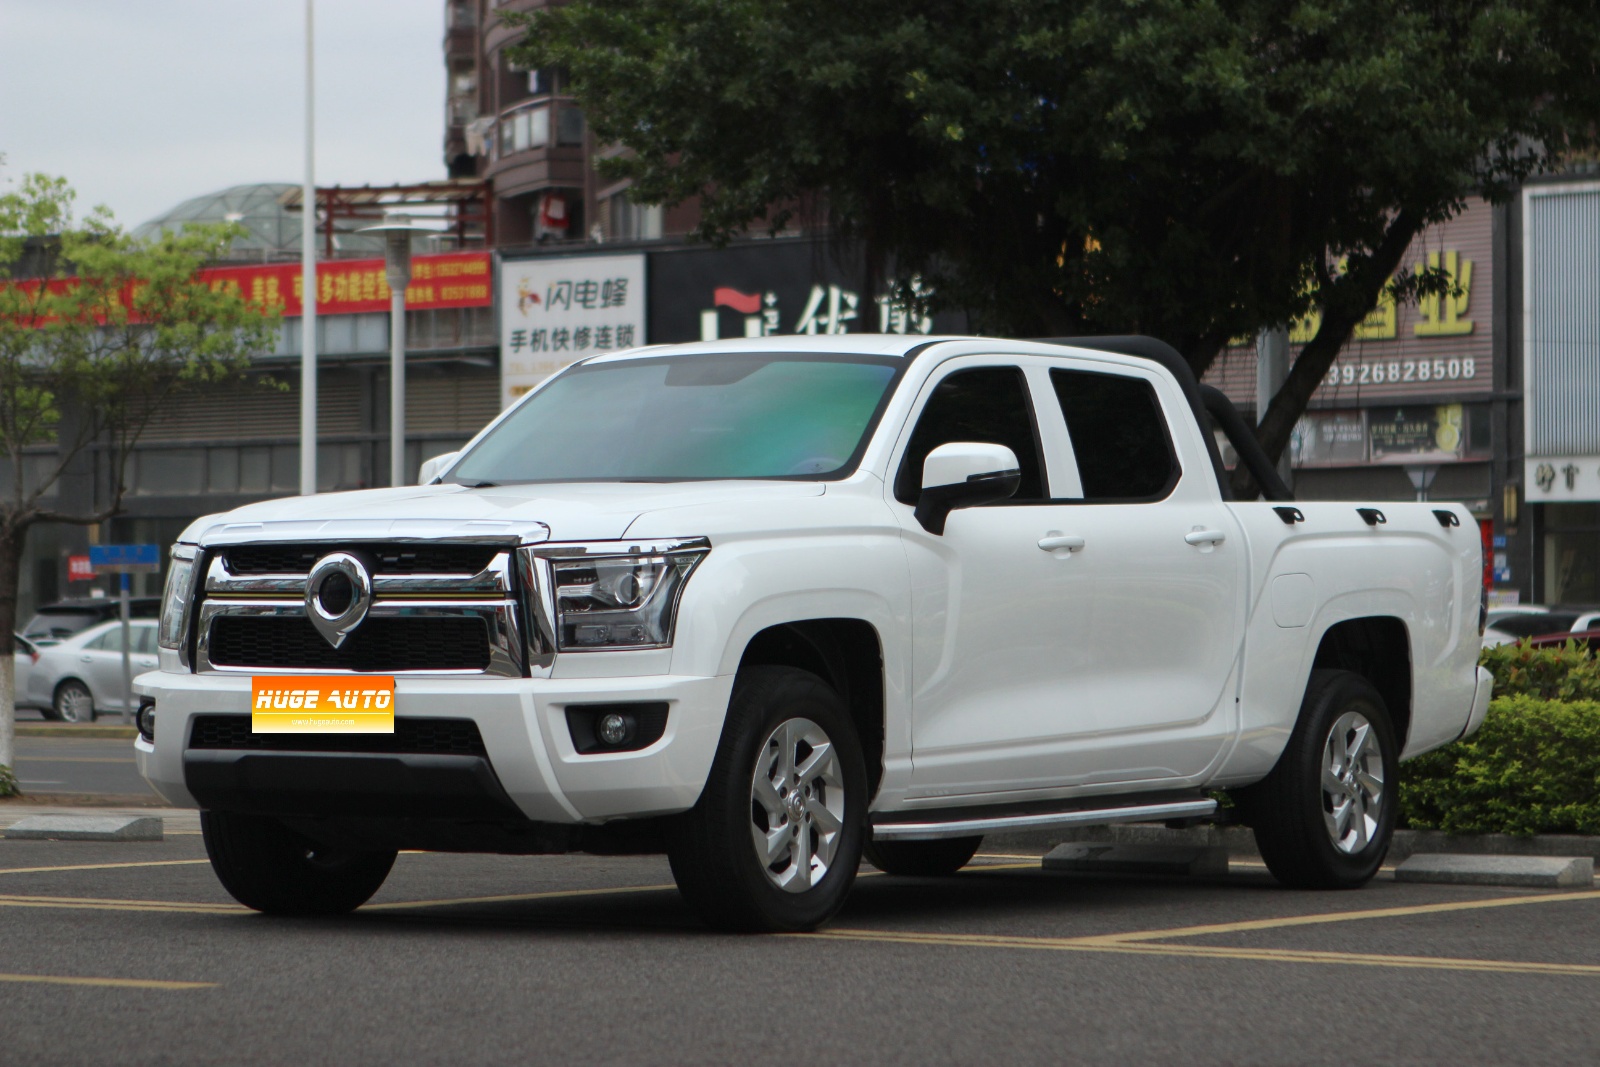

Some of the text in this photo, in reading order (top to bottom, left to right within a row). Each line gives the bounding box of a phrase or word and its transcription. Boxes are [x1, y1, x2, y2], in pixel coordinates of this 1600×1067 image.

[545, 278, 629, 312] 闪电蜂
[509, 324, 635, 353] 手机快修连锁
[1321, 357, 1475, 387] 3926828508
